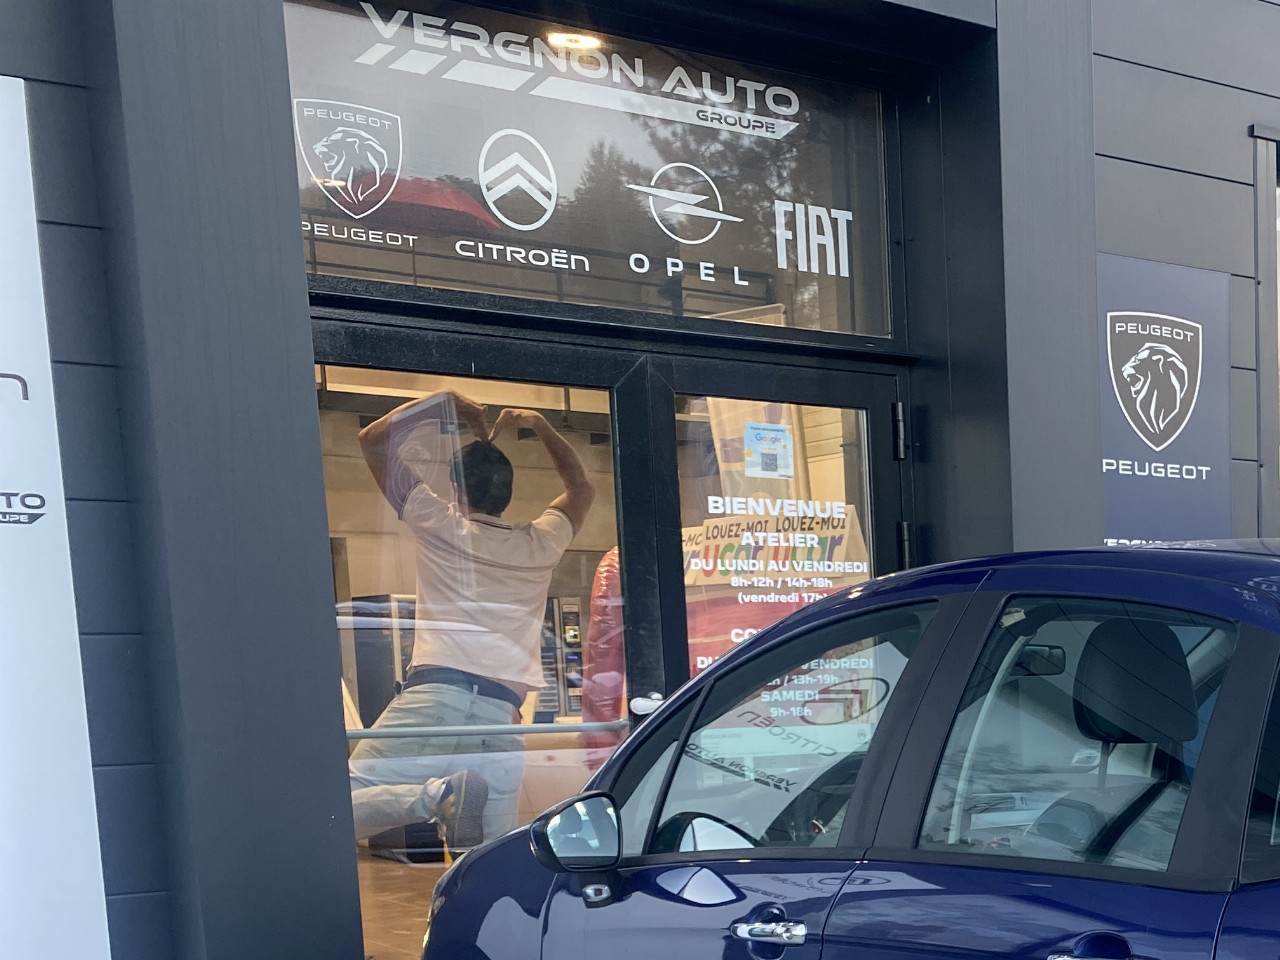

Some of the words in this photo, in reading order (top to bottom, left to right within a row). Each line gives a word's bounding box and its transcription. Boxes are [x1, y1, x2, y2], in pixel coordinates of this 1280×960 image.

[358, 1, 645, 88] VERGNON
[661, 66, 801, 116] AUTO
[303, 108, 392, 129] PEUGEOT
[696, 108, 777, 134] GROUPE
[774, 199, 853, 278] FIAT
[629, 253, 749, 286] OPEL
[1115, 322, 1195, 342] PEUGEOT
[1102, 459, 1211, 480] PEUGEOT
[0, 492, 46, 510] TO
[707, 496, 846, 518] BIENVENUE
[706, 520, 769, 540] LOUEZ-MOI
[775, 515, 846, 532] LOUEZ-MOI
[741, 532, 819, 548] ATELIER
[690, 558, 713, 571] DU
[717, 559, 764, 571] LUNDI
[768, 560, 789, 571] AU
[792, 561, 867, 573] VENDREDI
[730, 577, 774, 588] 8h-12h
[785, 577, 833, 588] 14h-18h
[738, 592, 799, 604] (vendredi
[792, 674, 838, 685] 13h-19h
[760, 690, 820, 702] SAMEDI
[770, 707, 812, 717] 9h-18h
